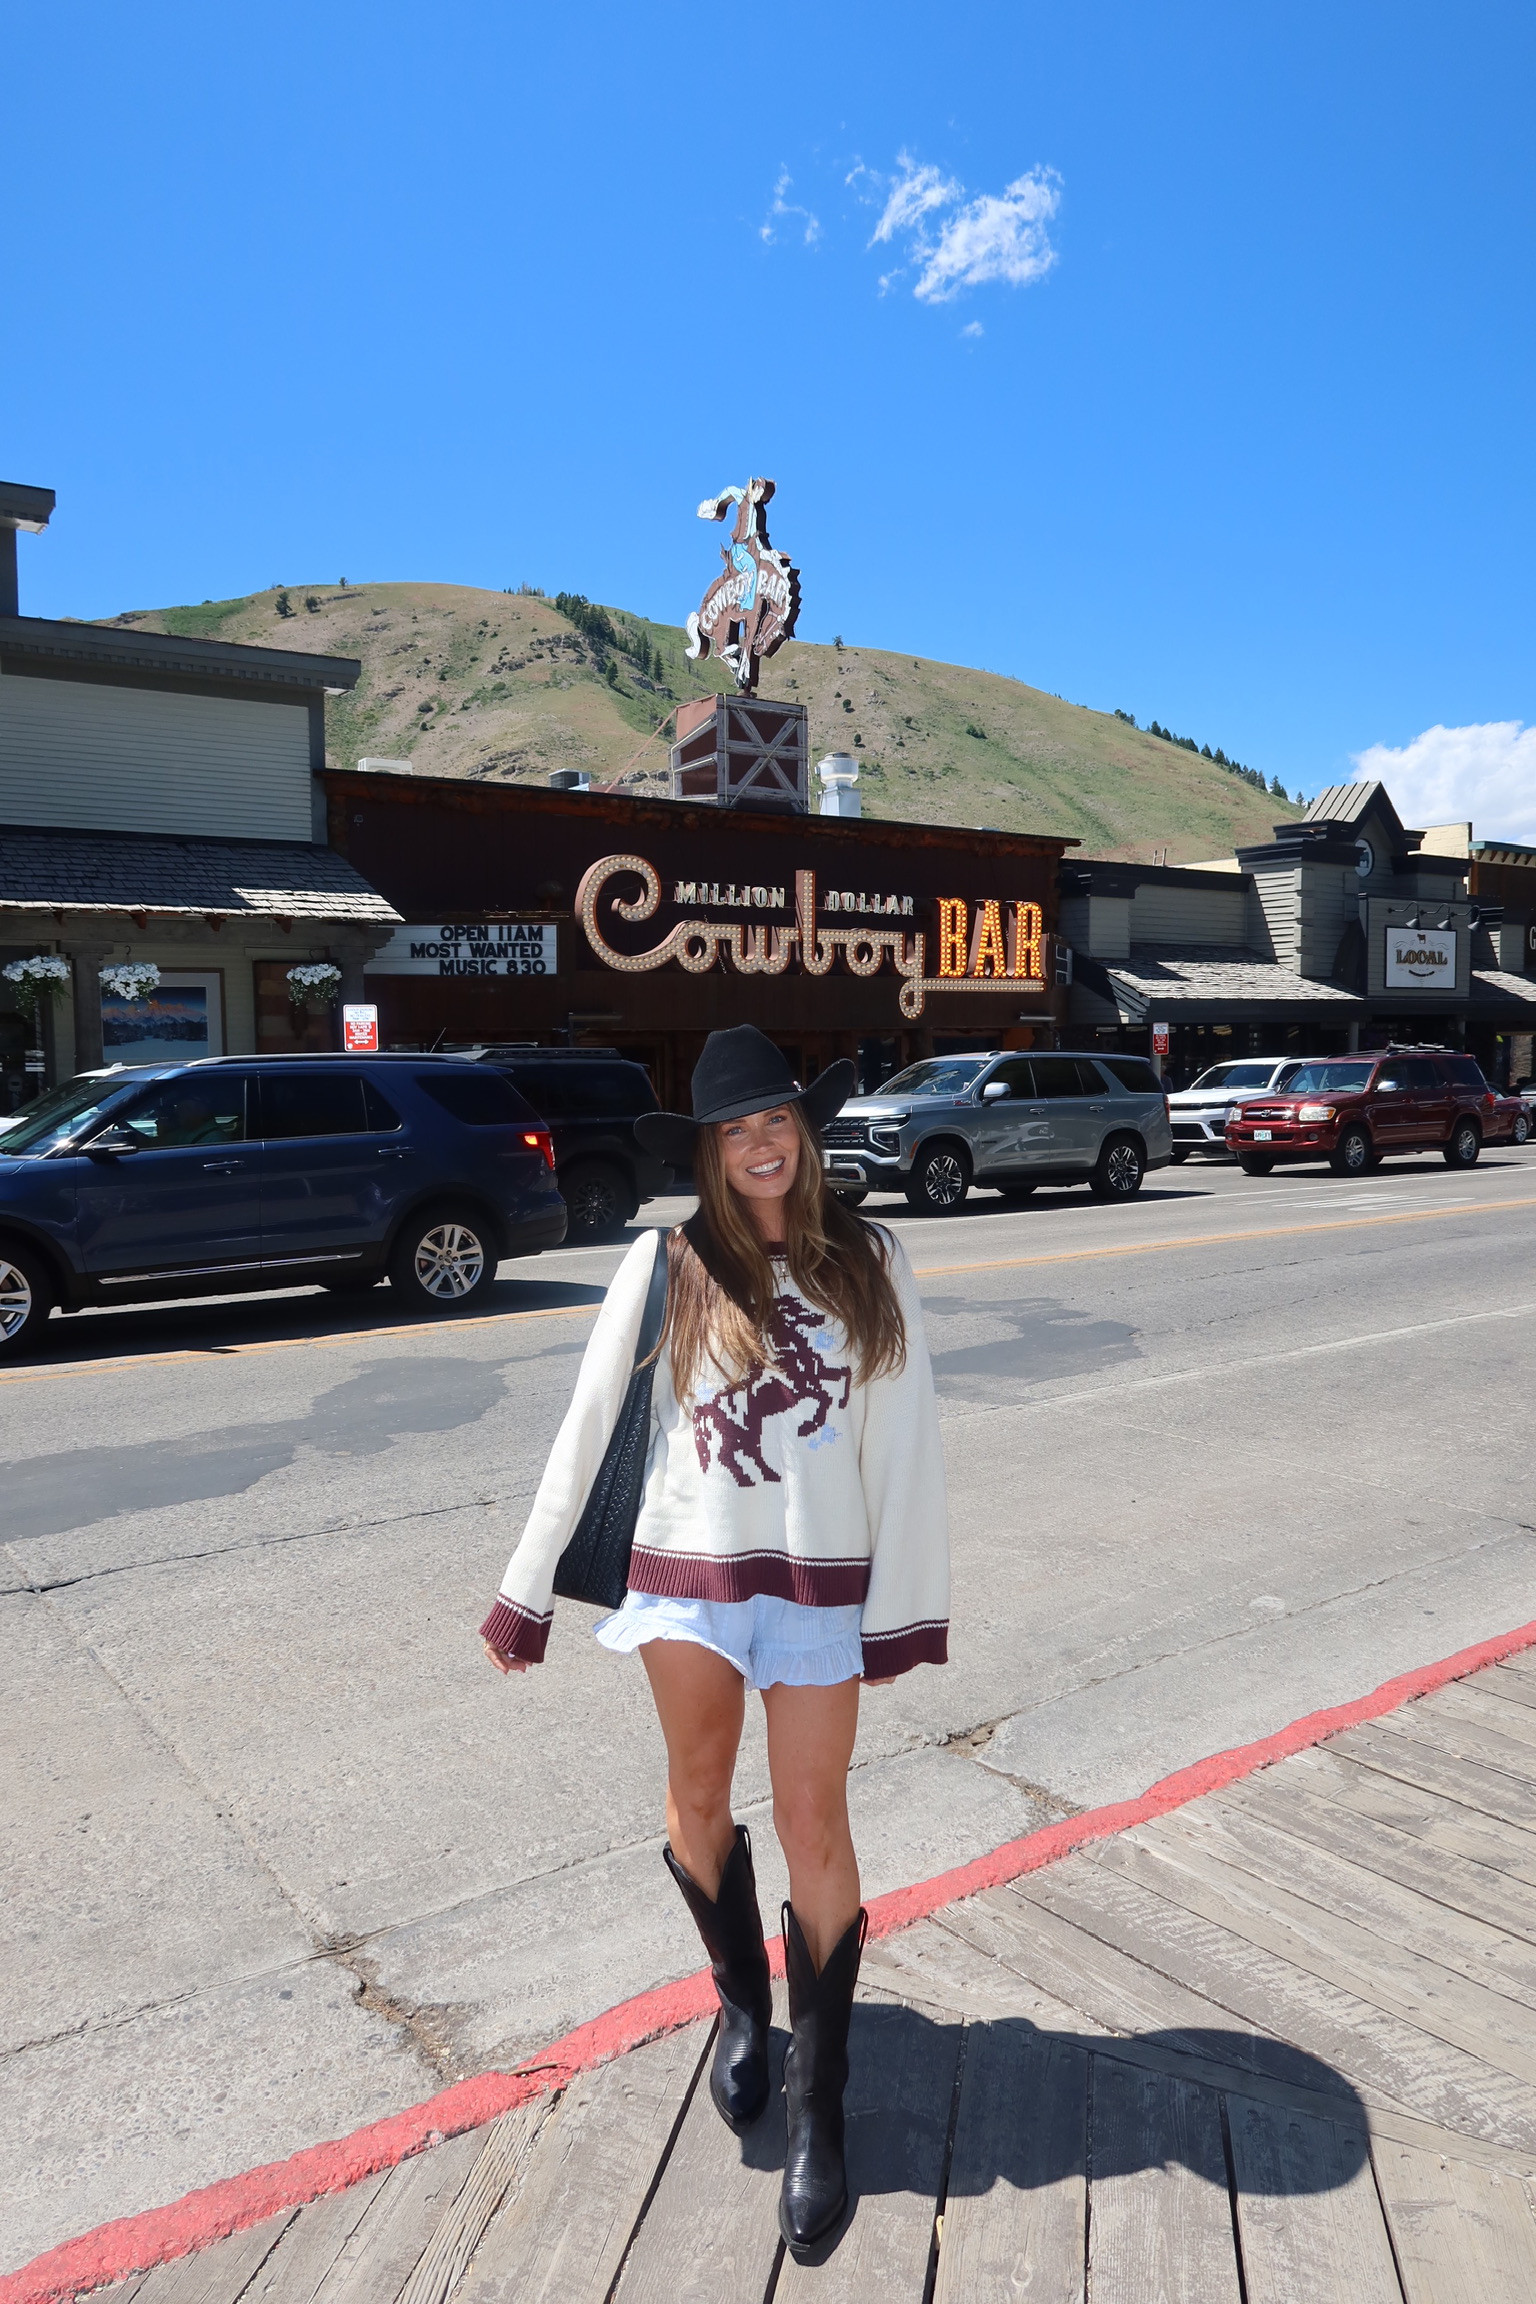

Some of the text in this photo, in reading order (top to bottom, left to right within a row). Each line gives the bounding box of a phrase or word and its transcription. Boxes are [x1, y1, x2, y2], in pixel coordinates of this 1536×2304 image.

[701, 570, 787, 630] COWBOY BAR
[674, 880, 914, 916] MILLION DOLLAR
[440, 925, 489, 942] OPEN
[575, 854, 1043, 1020] Cowboy BAR
[410, 942, 543, 959] MOST WANTED
[1395, 949, 1448, 966] LOCAL
[439, 959, 547, 976] MUSIC 830
